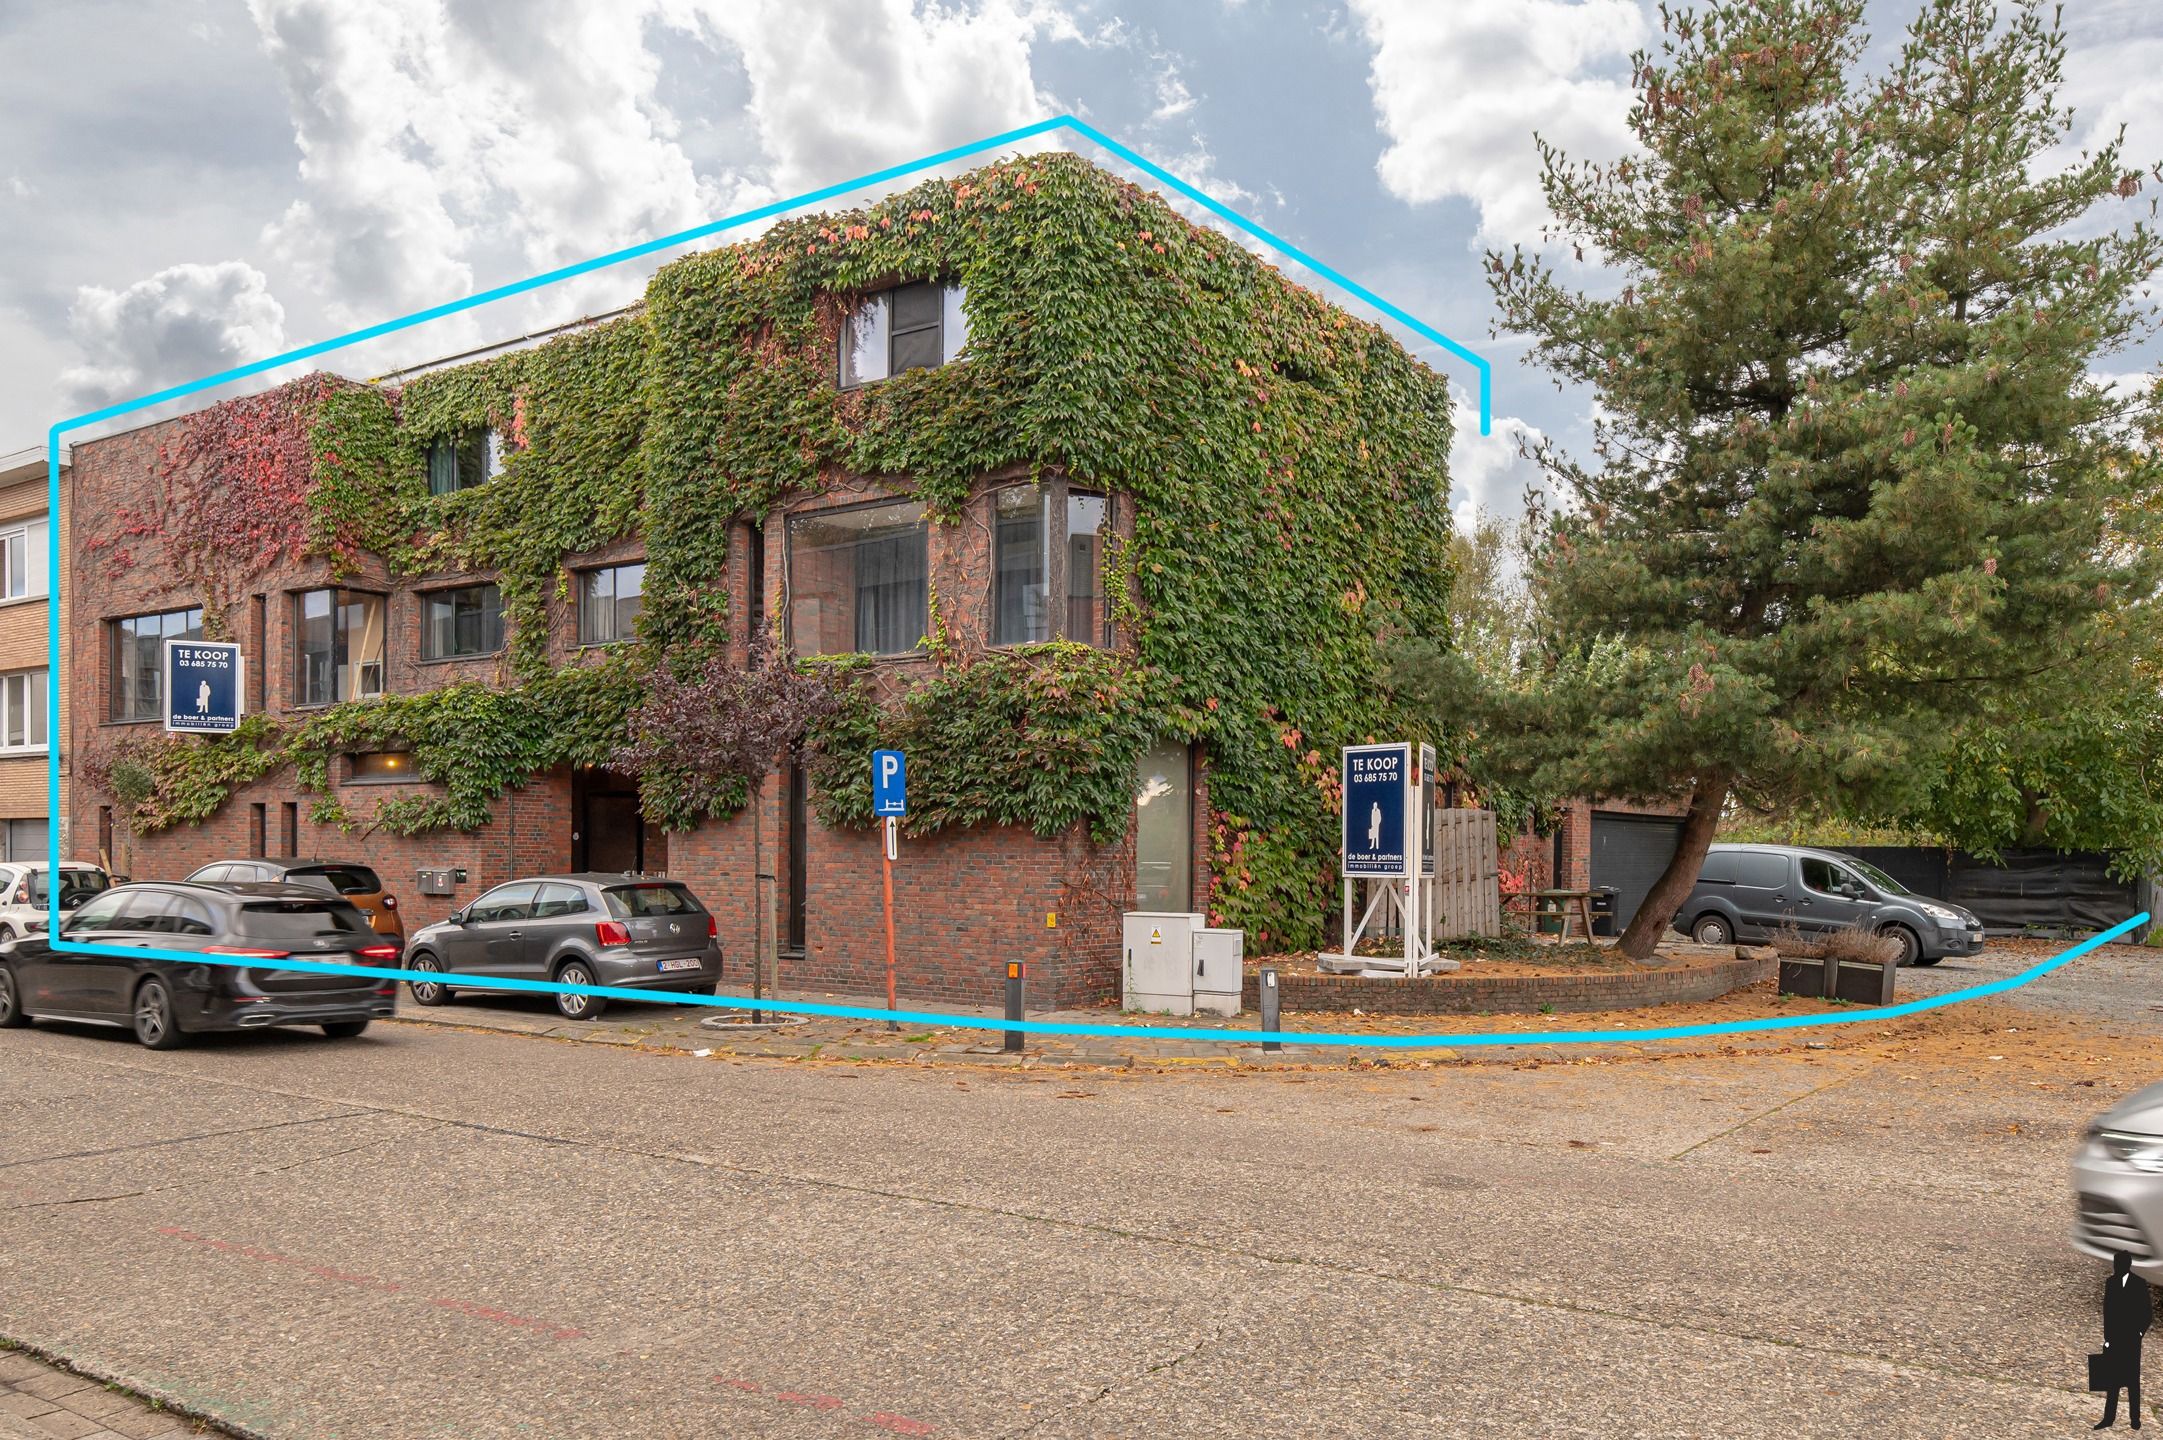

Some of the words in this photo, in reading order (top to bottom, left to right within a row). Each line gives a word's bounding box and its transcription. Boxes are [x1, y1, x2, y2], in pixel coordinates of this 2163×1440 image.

[178, 649, 191, 659] TE
[194, 650, 229, 660] KOOP
[1353, 759, 1364, 771] TE
[1367, 757, 1398, 771] KOOP
[882, 755, 898, 789] P
[1354, 774, 1363, 783] 03
[1364, 773, 1377, 782] 685
[1378, 772, 1387, 782] 75
[1388, 772, 1398, 781] 70
[1377, 853, 1402, 862] partners
